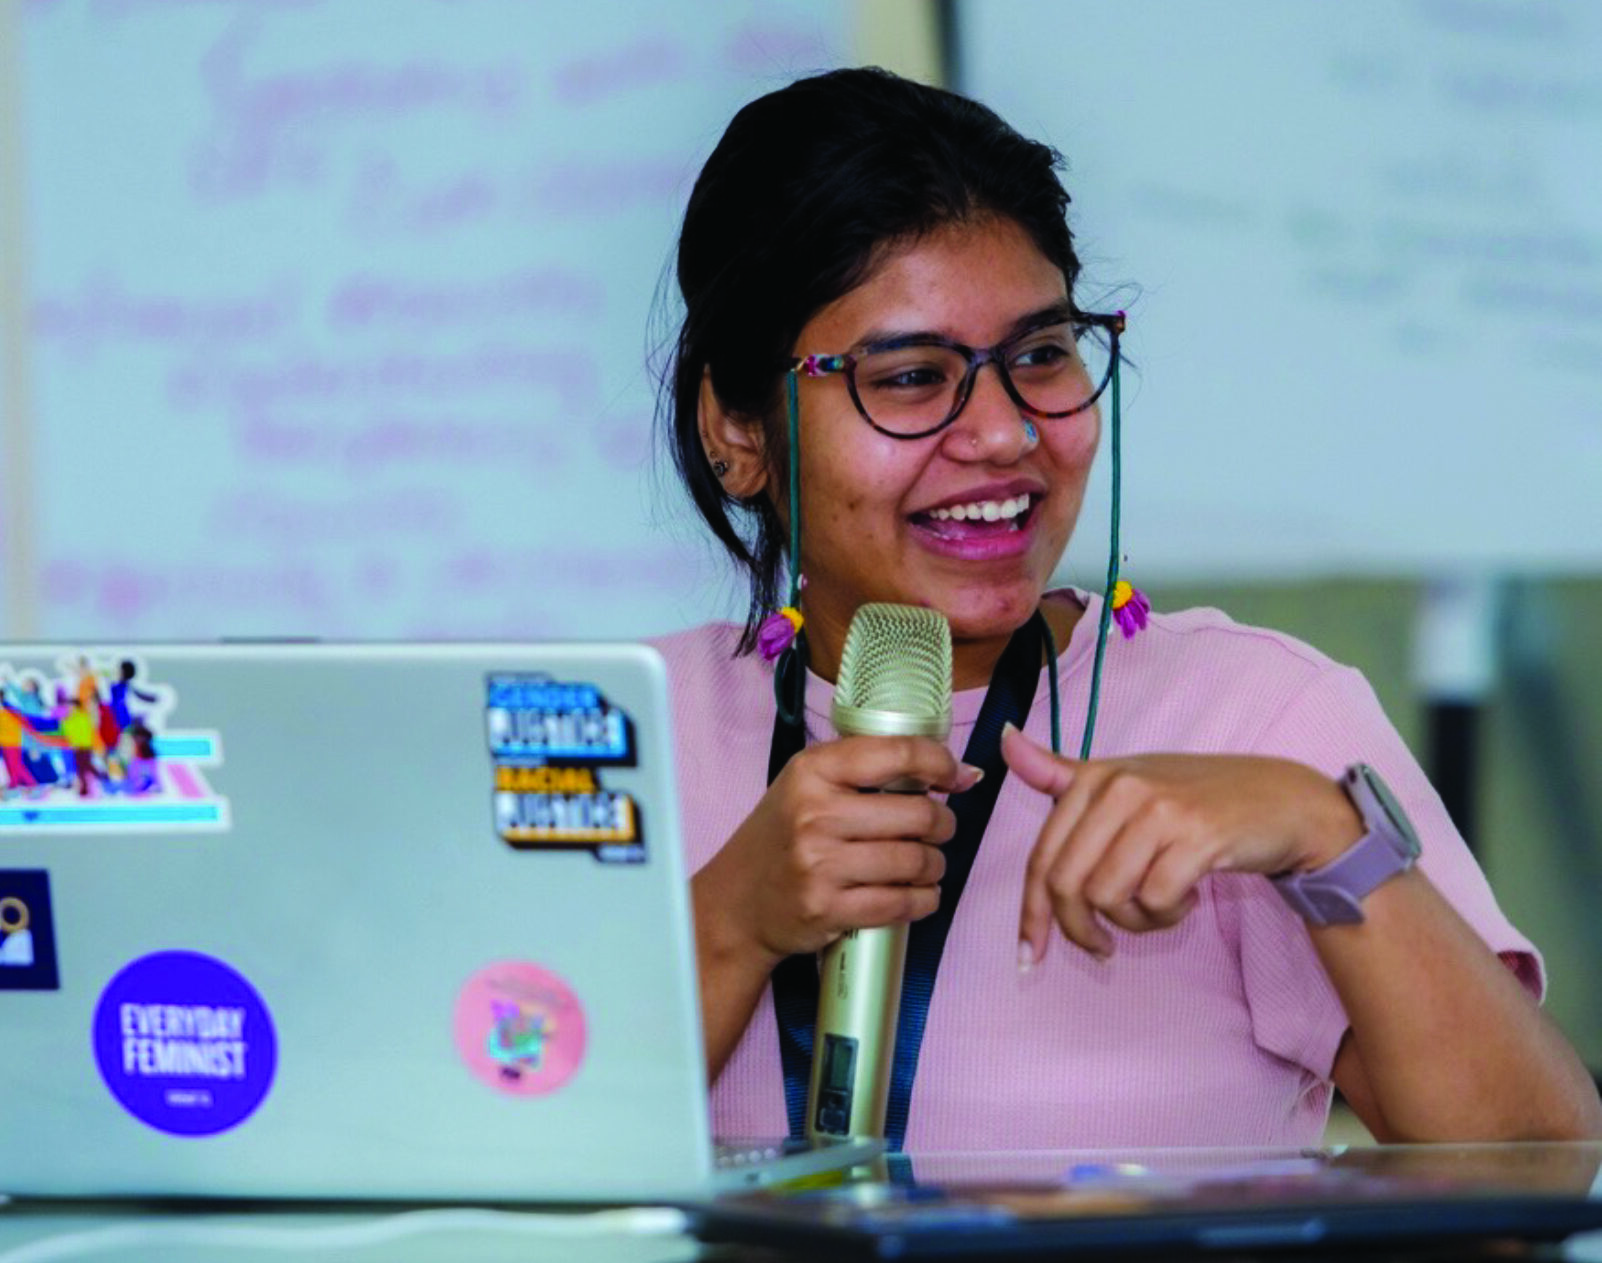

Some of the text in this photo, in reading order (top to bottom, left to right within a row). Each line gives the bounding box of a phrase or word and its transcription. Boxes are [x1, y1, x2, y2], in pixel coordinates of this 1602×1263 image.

[488, 707, 623, 747] JUSTICE
[497, 792, 632, 830] JUSTICE
[121, 1003, 245, 1037] EVERYDAY
[123, 1038, 246, 1077] FEMINIST
